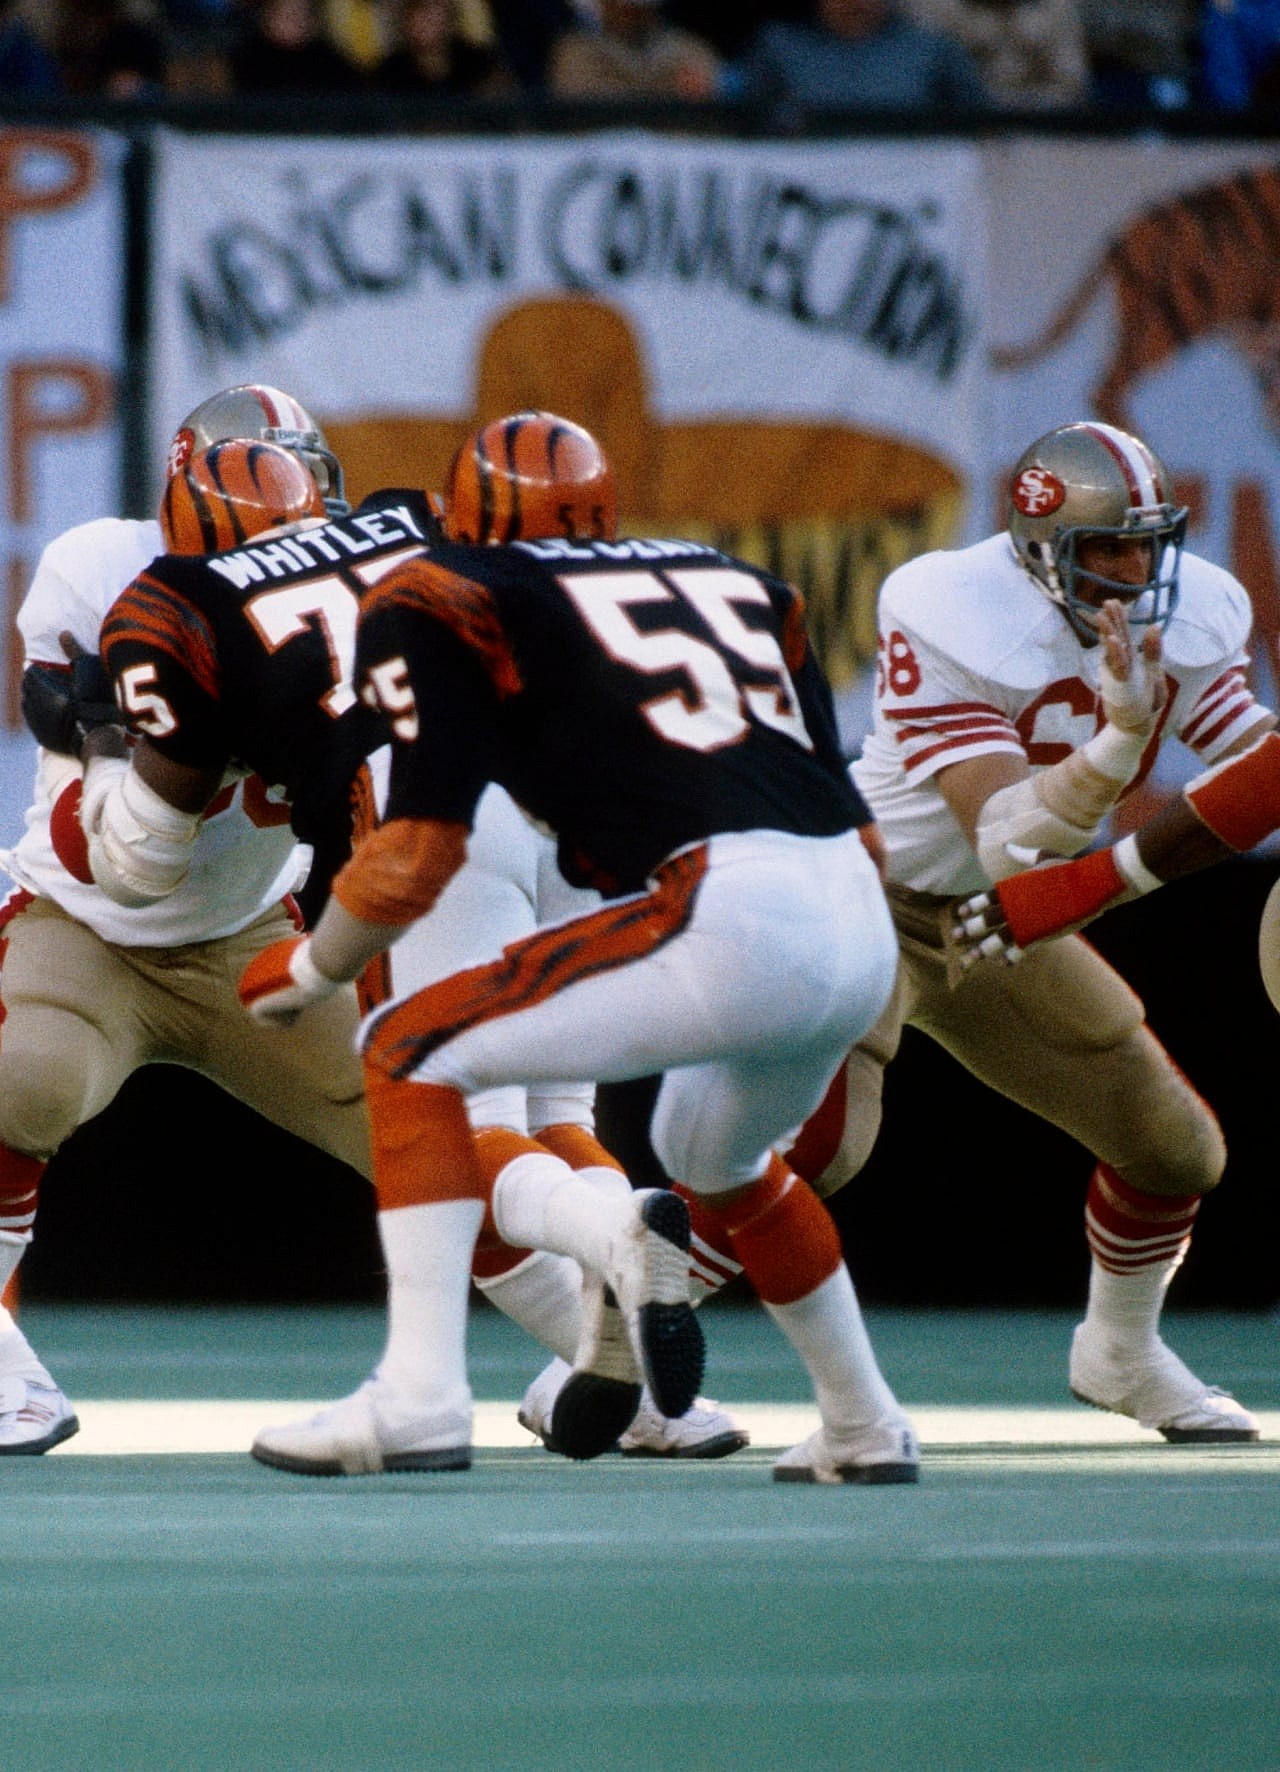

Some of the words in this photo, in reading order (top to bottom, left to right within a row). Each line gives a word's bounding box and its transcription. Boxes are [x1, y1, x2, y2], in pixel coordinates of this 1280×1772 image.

[1018, 468, 1055, 513] SF
[206, 505, 426, 591] WHITLEY
[243, 545, 430, 721] 7
[555, 566, 816, 753] 55
[114, 661, 180, 738] 5
